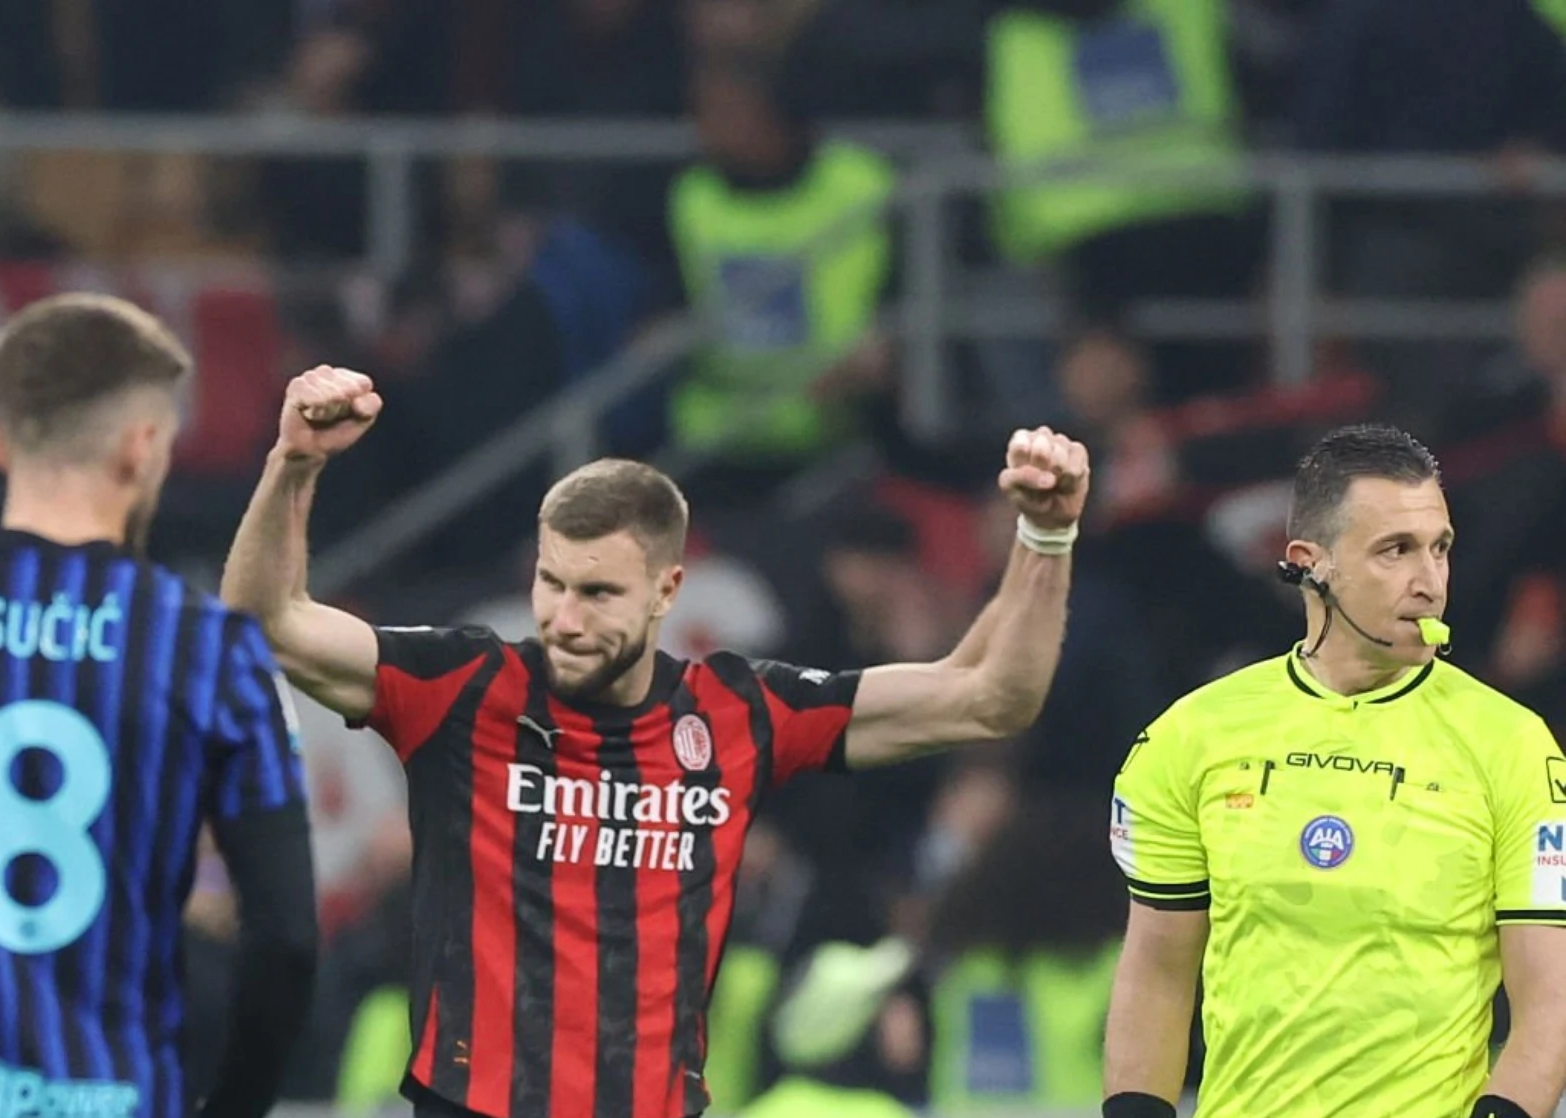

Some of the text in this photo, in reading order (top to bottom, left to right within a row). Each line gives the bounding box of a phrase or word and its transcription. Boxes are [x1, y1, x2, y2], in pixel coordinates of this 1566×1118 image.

[1286, 752, 1394, 776] GIVOVA
[507, 763, 731, 826] Emirates
[536, 822, 694, 871] FLY BETTER
